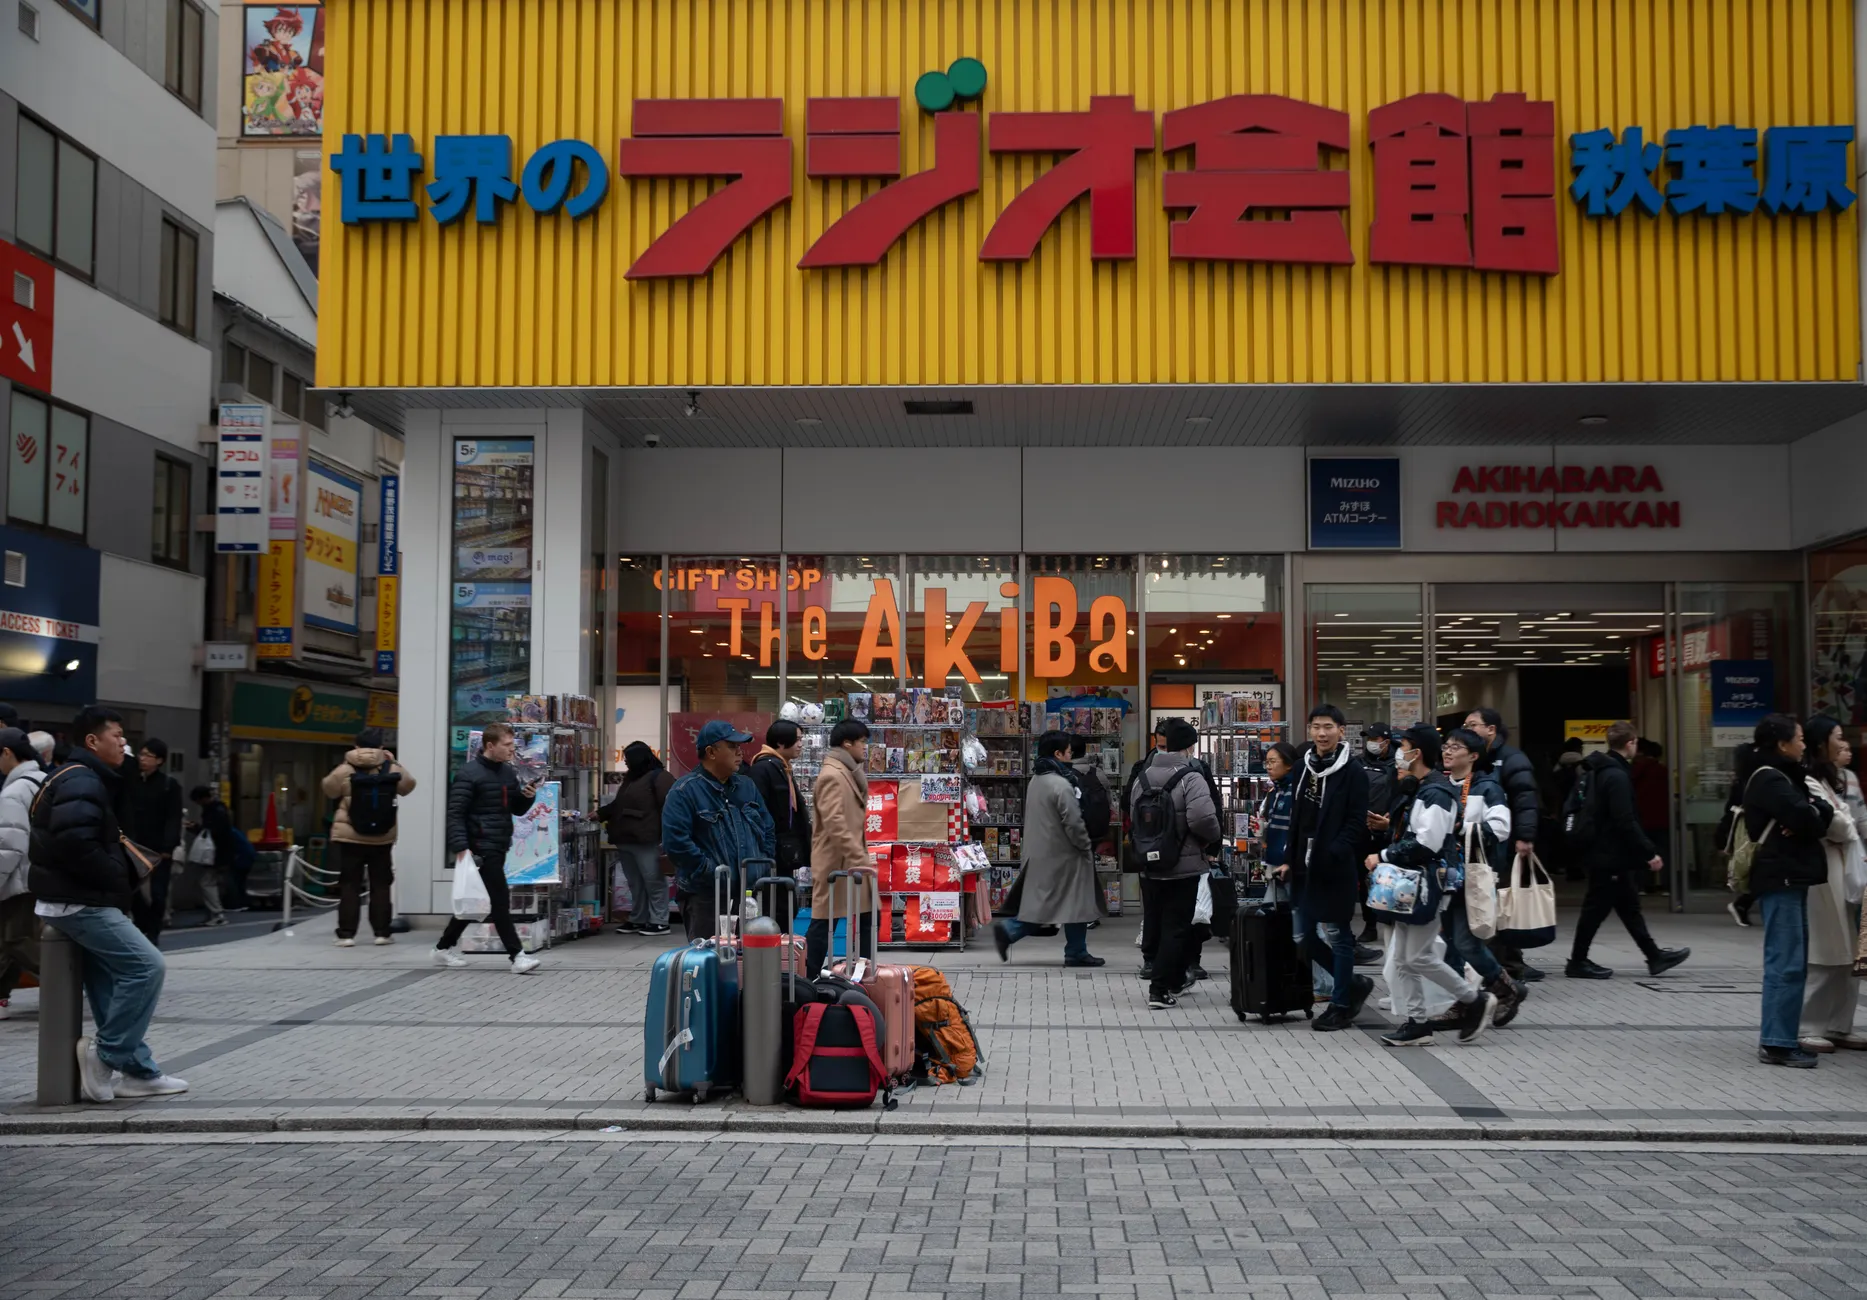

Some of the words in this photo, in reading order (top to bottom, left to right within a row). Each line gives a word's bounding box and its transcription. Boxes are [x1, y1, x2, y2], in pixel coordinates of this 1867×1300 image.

[330, 133, 609, 225] 世界の
[619, 58, 1560, 280] ラジオ会館
[1568, 124, 1857, 217] 秋葉原
[56, 444, 80, 470] アイ
[223, 449, 260, 462] アコム
[460, 445, 475, 456] 5F
[55, 472, 80, 496] フル
[1330, 477, 1380, 489] MIZUHO
[1452, 465, 1664, 494] AKIHABARA
[1339, 500, 1371, 511] みずほ
[1436, 500, 1681, 529] RADIOKAIKAN
[1324, 512, 1387, 524] ATMコーナー
[487, 552, 513, 565] magi
[268, 543, 282, 626] カードラッシュ
[653, 568, 726, 592] GIFT
[735, 568, 822, 592] SHOP
[458, 587, 473, 598] 5F
[1, 612, 41, 633] ACCESS
[46, 620, 80, 639] TICKET
[717, 597, 828, 667] The
[485, 698, 506, 707] mag
[866, 794, 883, 833] 福袋
[904, 851, 922, 884] 福袋
